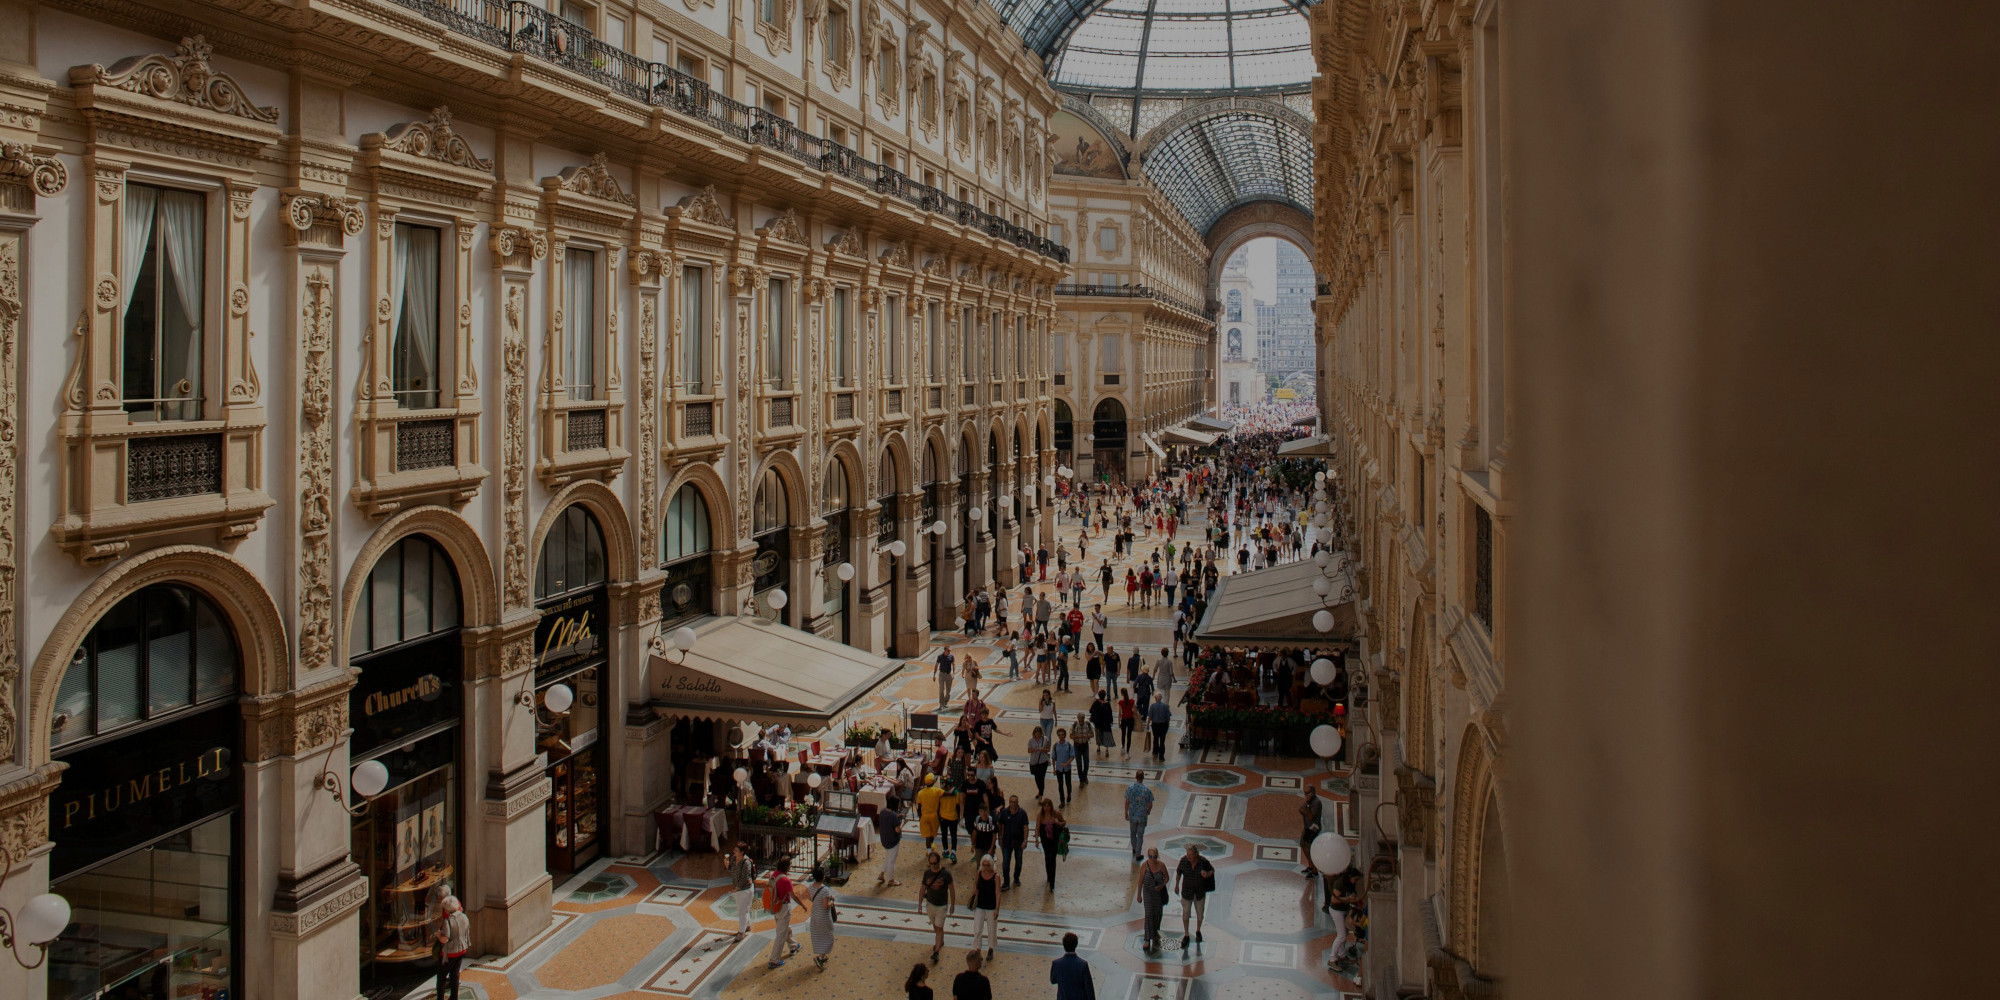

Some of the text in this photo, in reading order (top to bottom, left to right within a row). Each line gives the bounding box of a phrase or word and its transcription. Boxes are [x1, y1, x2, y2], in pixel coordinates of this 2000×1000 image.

[364, 674, 441, 716] Church's
[661, 675, 722, 693] il Salotto
[63, 748, 223, 829] PIUMELLI
